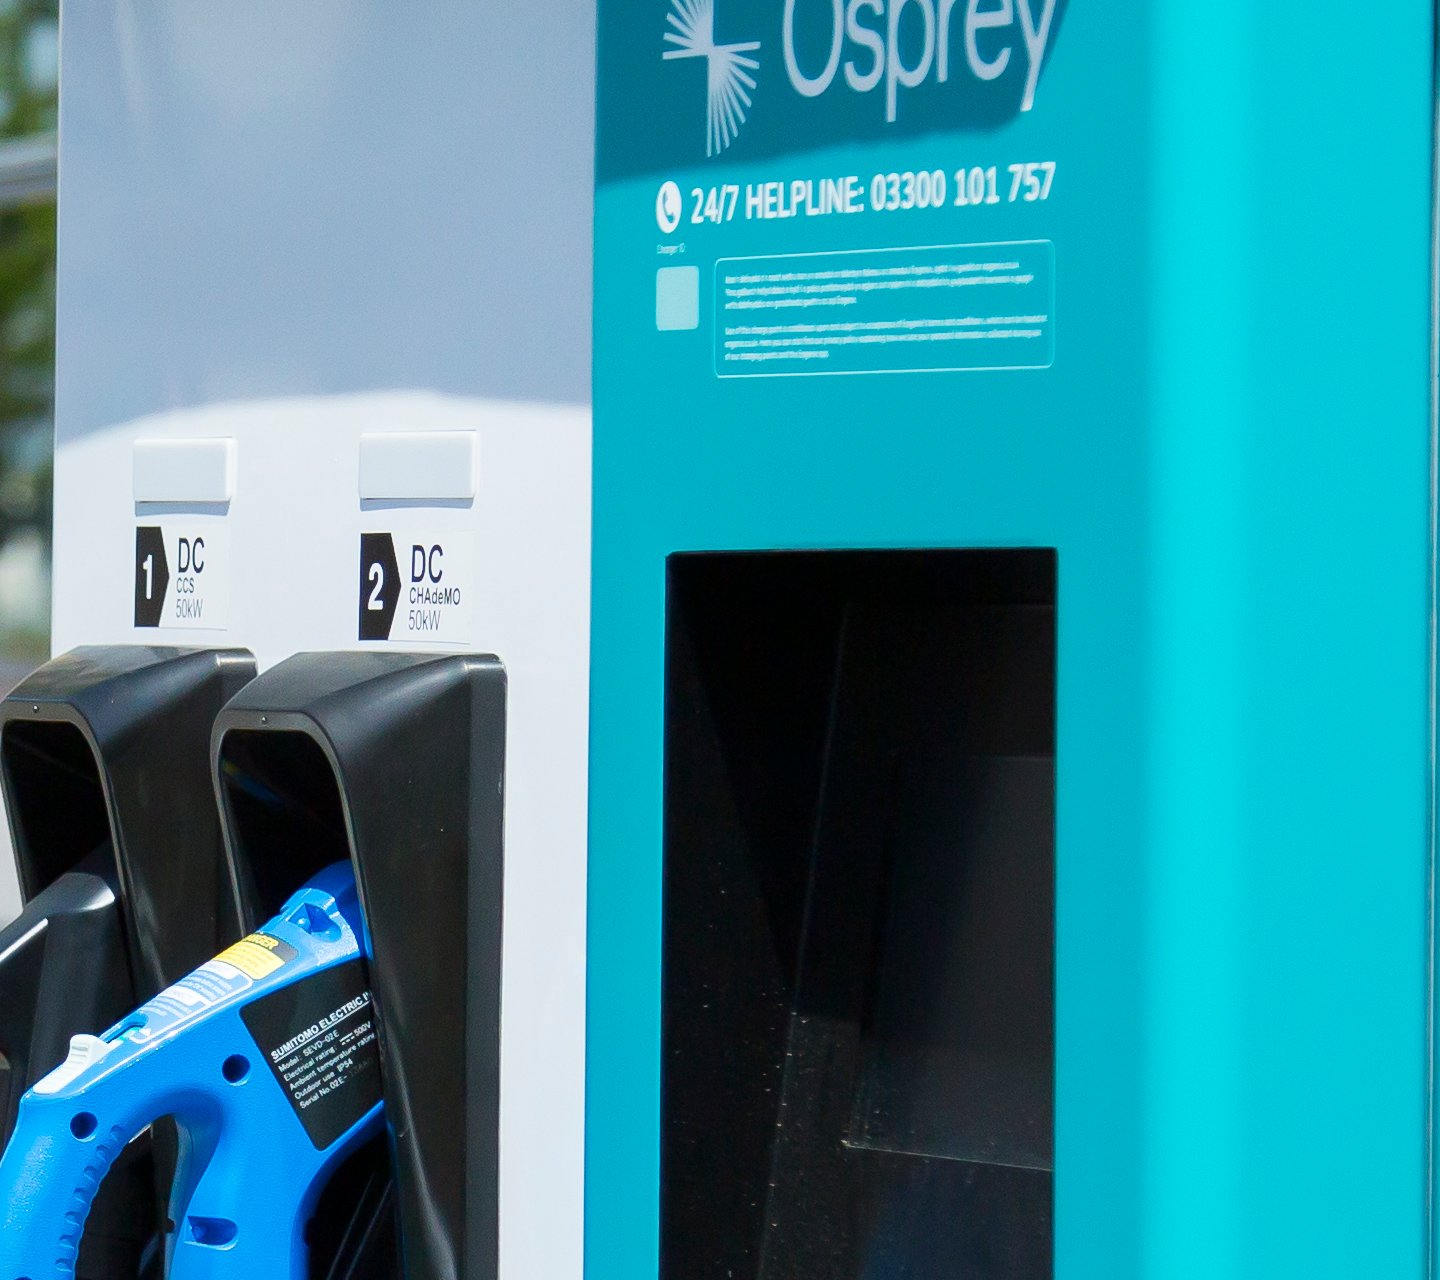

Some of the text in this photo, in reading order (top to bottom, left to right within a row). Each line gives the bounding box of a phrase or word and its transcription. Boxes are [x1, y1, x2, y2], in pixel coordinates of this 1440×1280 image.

[690, 161, 1056, 225] 24/7 HELPLINE: 03300 101 757
[177, 536, 205, 574] DC
[411, 544, 444, 583] DC
[142, 554, 154, 600] 1
[176, 577, 195, 594] CCS
[367, 562, 384, 611] 2
[175, 598, 203, 619] 50kW
[409, 587, 461, 606] CHAdeMO
[408, 610, 441, 631] 50kW
[270, 1024, 319, 1060] SUMITOMO
[318, 996, 363, 1028] ELECTRIC
[302, 1029, 340, 1057] SEVD-02E
[283, 1057, 315, 1081] Electrical
[289, 1069, 317, 1091] Ambient
[317, 1044, 357, 1072] temperature
[294, 1078, 321, 1100] Outdoor
[322, 1071, 335, 1082] use
[336, 1058, 353, 1072] IP54
[299, 1092, 320, 1109] Serial
